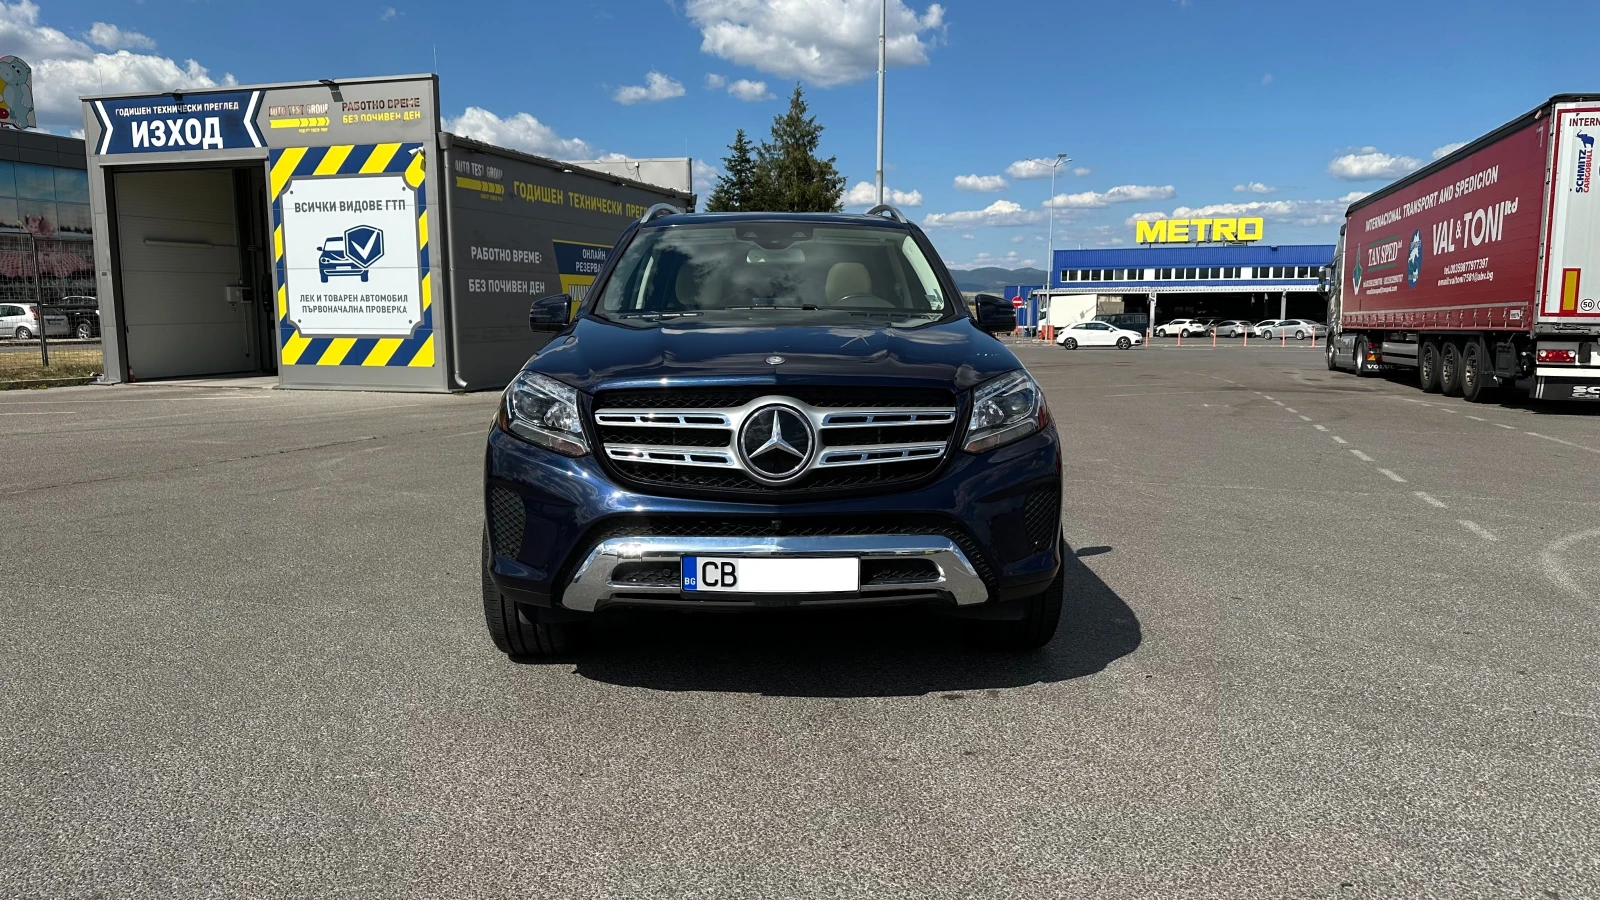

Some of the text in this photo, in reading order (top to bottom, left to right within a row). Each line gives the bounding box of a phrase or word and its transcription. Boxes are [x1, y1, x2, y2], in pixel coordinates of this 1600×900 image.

[115, 102, 239, 117] ГОДИШЕН ТЕХНИЧЕСКИ ПРЕГЛЕД
[288, 105, 304, 116] TEST
[306, 103, 329, 114] GROUP
[342, 98, 420, 111] РАБОТНО ВРЕМЕ
[342, 110, 420, 124] БЕЗ ПОЧИВЕН ДЕН
[131, 116, 224, 150] ИЗХОД
[471, 162, 484, 176] TEST
[1575, 149, 1587, 193] SCHMITZ
[1583, 149, 1593, 193] CARGOBULL
[513, 181, 564, 205] ГОДИШЕН
[568, 192, 623, 216] ТЕХНИЧЕСКИ
[1402, 191, 1439, 218] TRANSPORT
[1439, 184, 1454, 205] AND
[1454, 164, 1499, 198] SPEDICION
[294, 199, 406, 213] ВСИЧКИ ВИДОВЕ ГТП
[1136, 217, 1264, 243] METRO
[1433, 196, 1519, 256] VAL & TONI ltd
[471, 246, 542, 264] РАБОТНО ВРЕМЕ:
[582, 248, 606, 260] ОНЛАЙН
[1380, 241, 1398, 264] SPED
[575, 261, 604, 273] РЕЗЕРВА
[468, 278, 545, 296] БЕЗ ПОЧИВЕН ДЕН
[300, 294, 408, 302] ЛЕК И ТОВАРЕН АВТОМОБИЛ
[302, 305, 408, 313] ПЪРВОНАЧАЛНА ПРОВЕРКА
[684, 577, 696, 586] BG
[701, 561, 738, 588] CB
